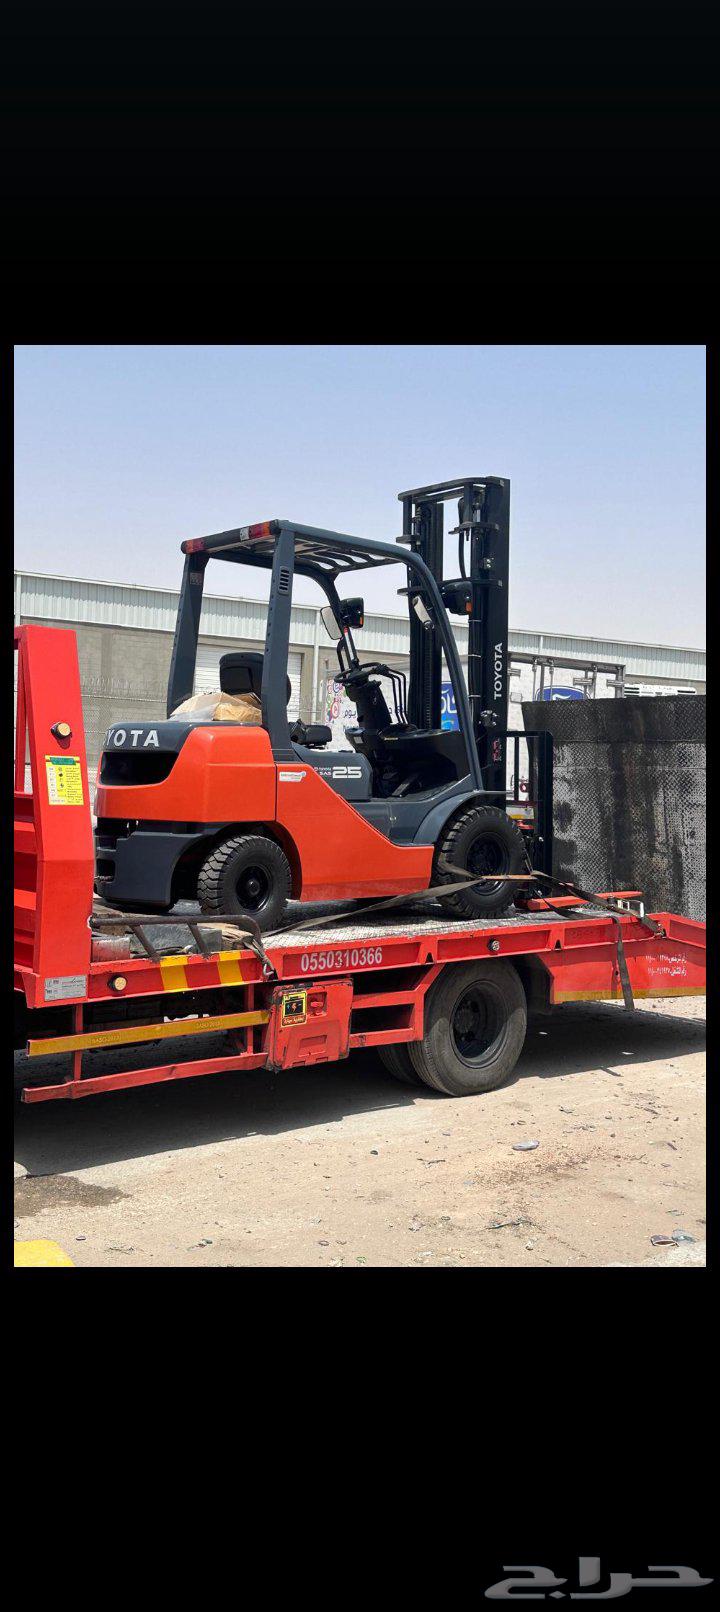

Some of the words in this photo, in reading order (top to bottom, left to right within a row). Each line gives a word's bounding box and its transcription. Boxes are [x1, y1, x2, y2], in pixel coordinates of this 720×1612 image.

[494, 642, 503, 700] TOYOTA
[103, 728, 160, 747] YOTA
[332, 766, 362, 779] 25
[301, 946, 383, 972] 0550310366
